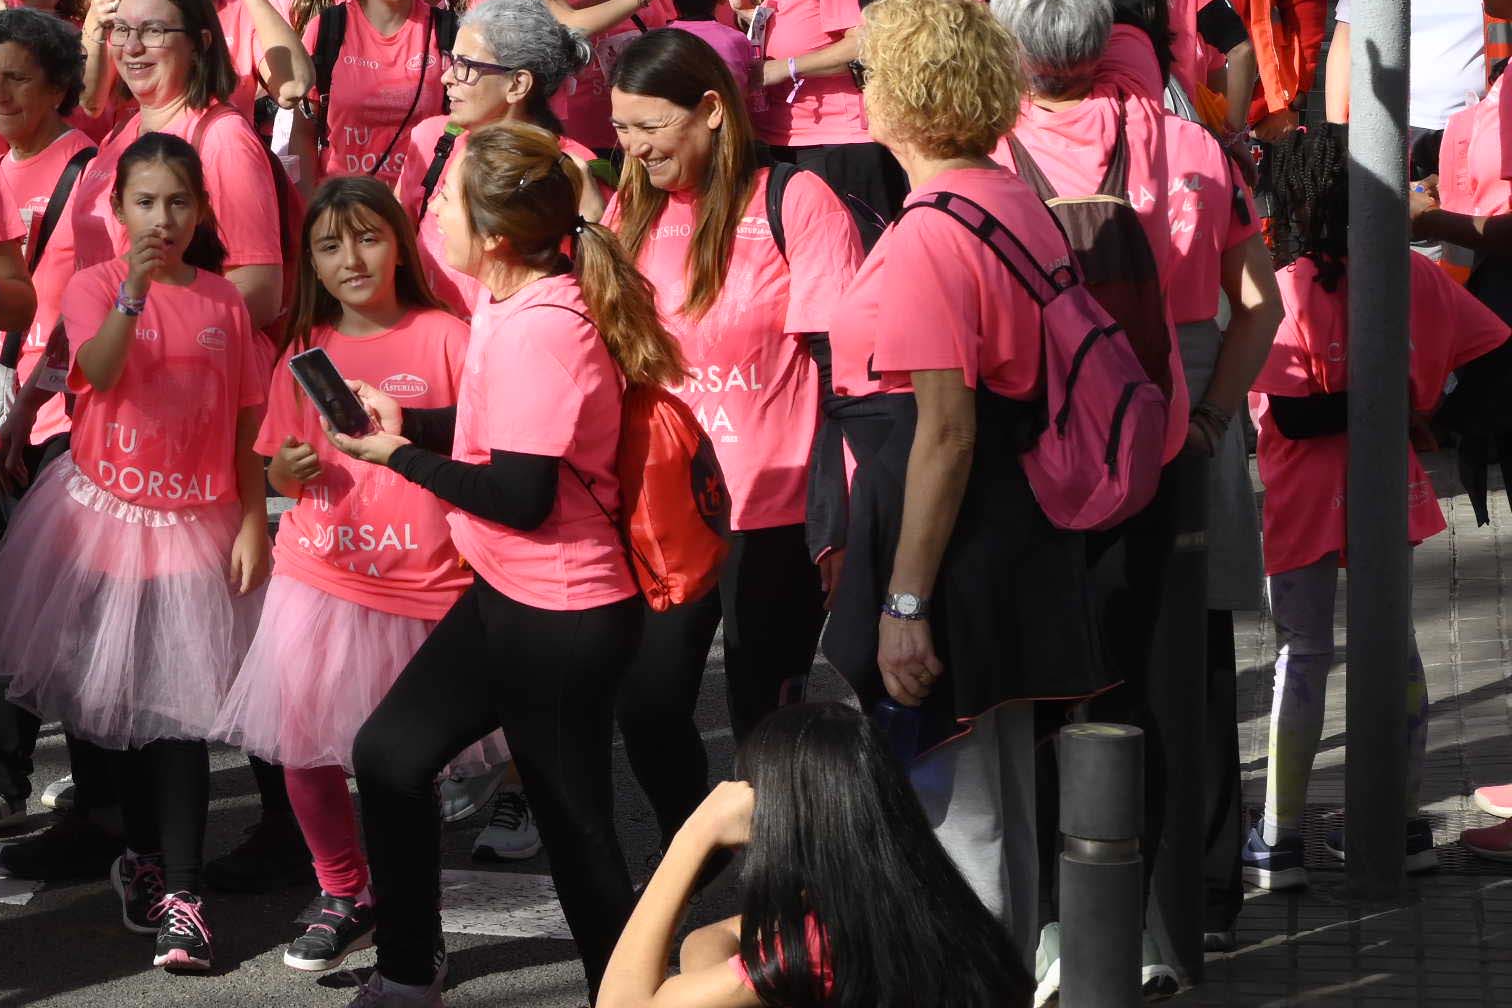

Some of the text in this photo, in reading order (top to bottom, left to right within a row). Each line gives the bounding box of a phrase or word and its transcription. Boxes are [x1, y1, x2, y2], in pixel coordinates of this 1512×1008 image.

[344, 126, 370, 146] TU
[383, 383, 426, 392] ASTURIANA
[106, 422, 137, 453] TU
[99, 460, 217, 501] DORSAL
[306, 485, 329, 512] TU
